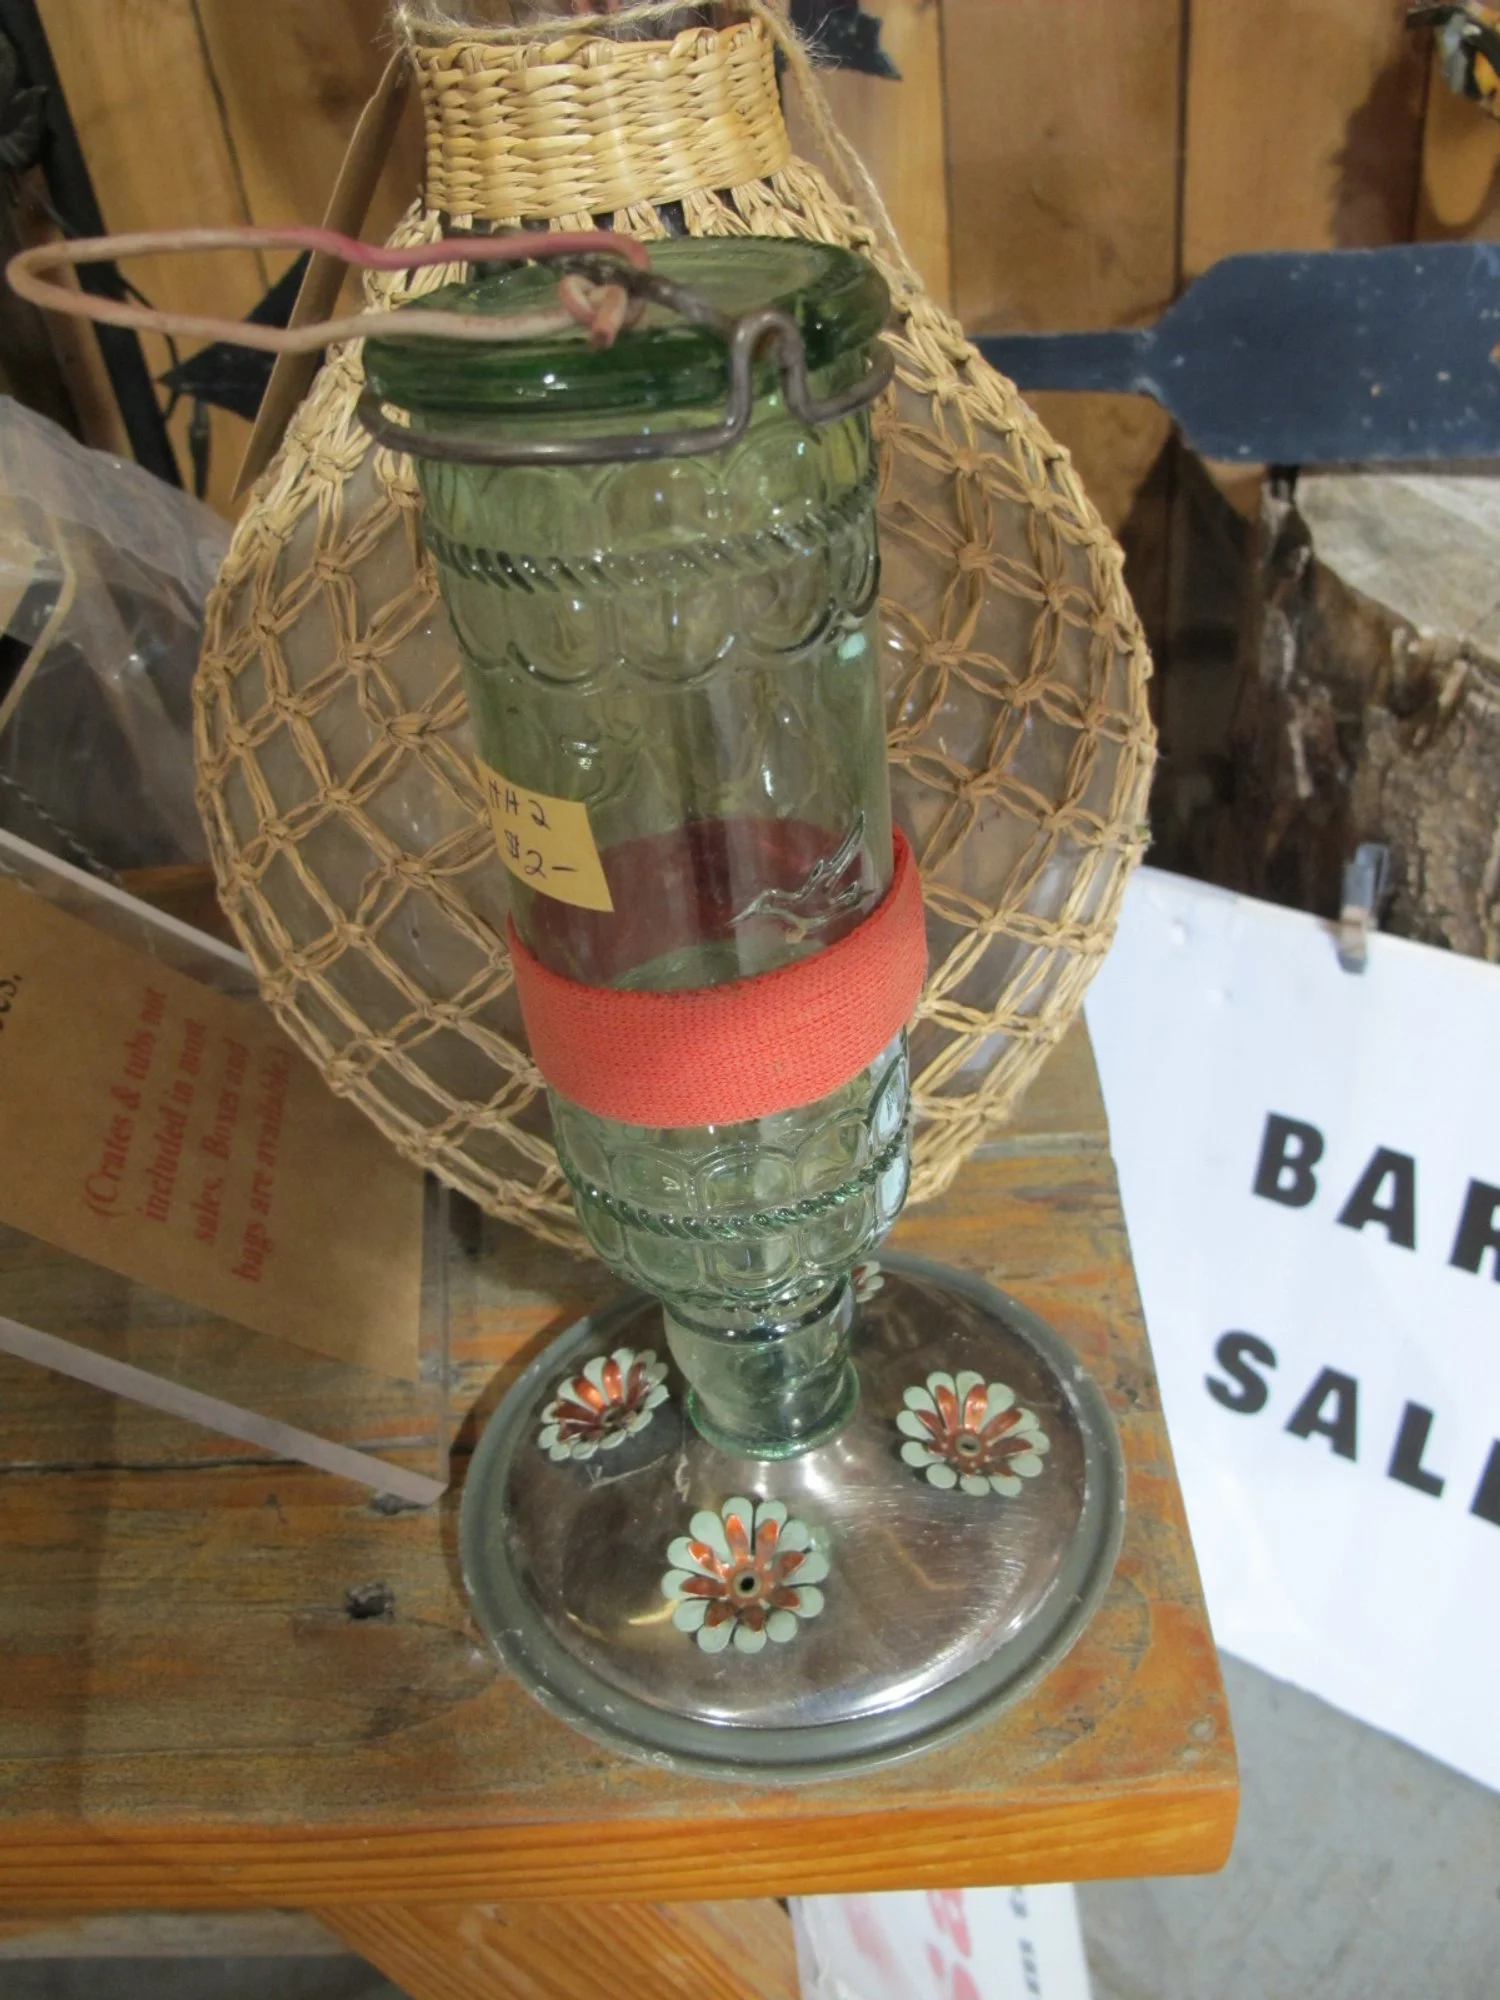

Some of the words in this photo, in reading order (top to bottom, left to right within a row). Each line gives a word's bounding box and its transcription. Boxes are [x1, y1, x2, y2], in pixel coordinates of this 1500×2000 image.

[138, 985, 168, 1026] not
[123, 1030, 155, 1081] tubs
[110, 1084, 142, 1111] &
[162, 1078, 194, 1105] in
[201, 1088, 240, 1161] Boxes
[83, 1112, 134, 1219] (Crates
[136, 1105, 190, 1223] included
[191, 1176, 225, 1245] sales.
[251, 1170, 274, 1216] are
[231, 1221, 275, 1282] bags
